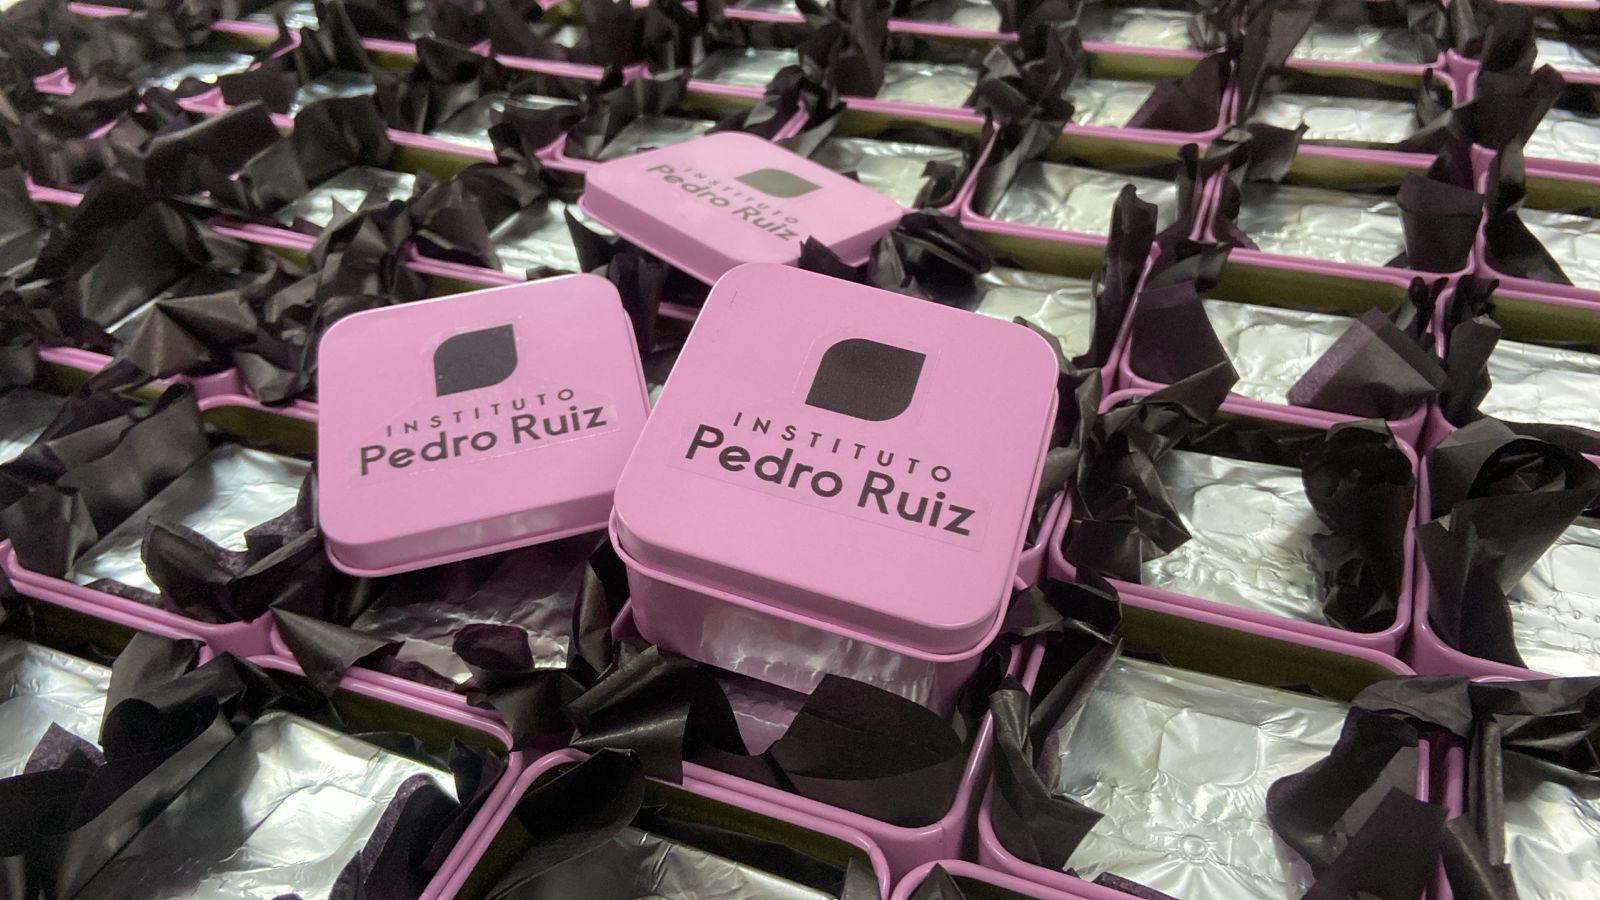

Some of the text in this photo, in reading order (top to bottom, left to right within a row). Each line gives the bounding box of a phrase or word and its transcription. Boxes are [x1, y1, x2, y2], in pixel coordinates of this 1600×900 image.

[646, 164, 798, 241] Pedro Ruiz
[683, 167, 798, 224] INSTITUTO
[360, 405, 607, 476] Pedro Ruiz
[387, 388, 574, 437] INSTITUTO
[733, 411, 952, 483] INSTITUTO
[685, 423, 976, 536] Pedro Ruiz
